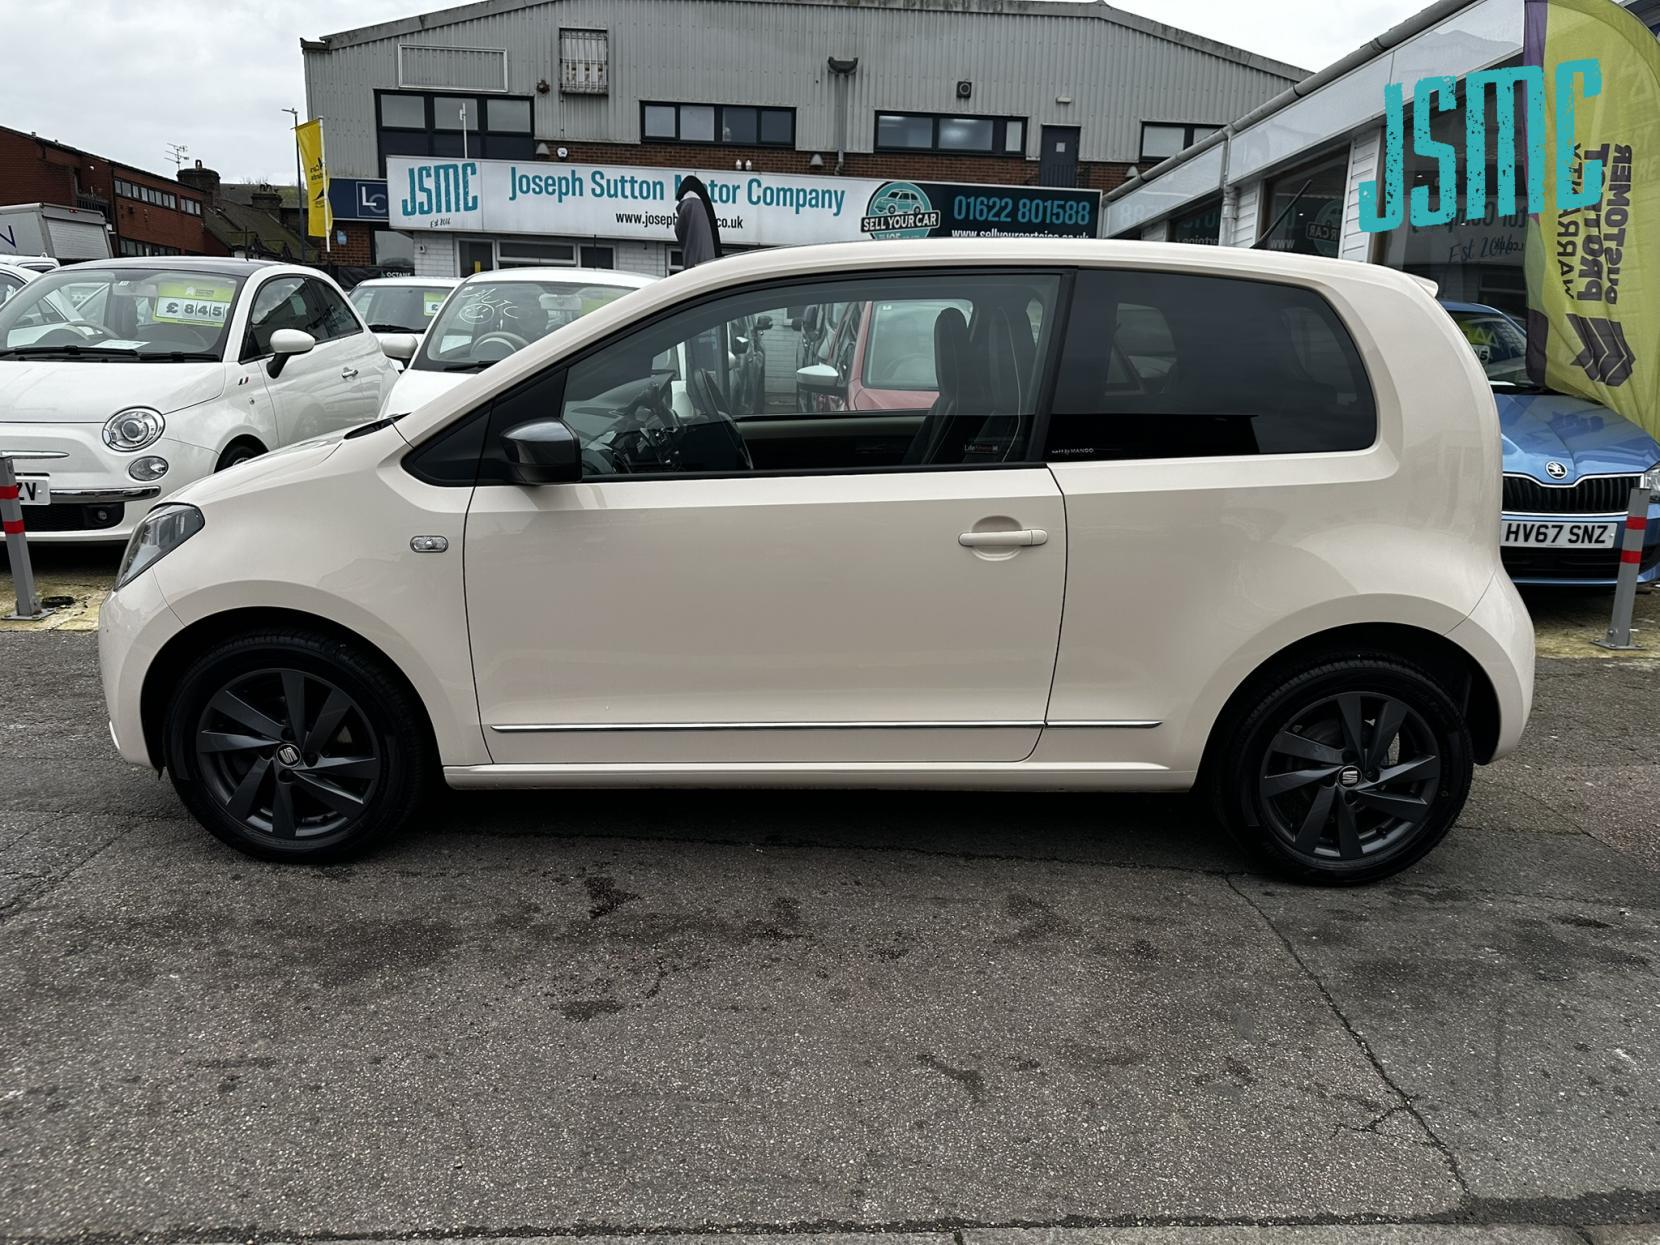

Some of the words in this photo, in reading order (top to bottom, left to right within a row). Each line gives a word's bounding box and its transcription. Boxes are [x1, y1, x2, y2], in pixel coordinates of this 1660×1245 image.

[401, 162, 478, 217] JSMC
[509, 166, 584, 203] Joseph
[590, 170, 665, 201] Sutton
[674, 174, 741, 205] tor
[747, 178, 846, 217] Company
[863, 217, 886, 231] SELL
[888, 215, 914, 229] YOUR
[915, 213, 937, 226] CAR
[953, 195, 1013, 222] 01622
[1017, 198, 1090, 225] 801588
[1504, 523, 1564, 544] HV67
[1568, 525, 1608, 544] SNZ
